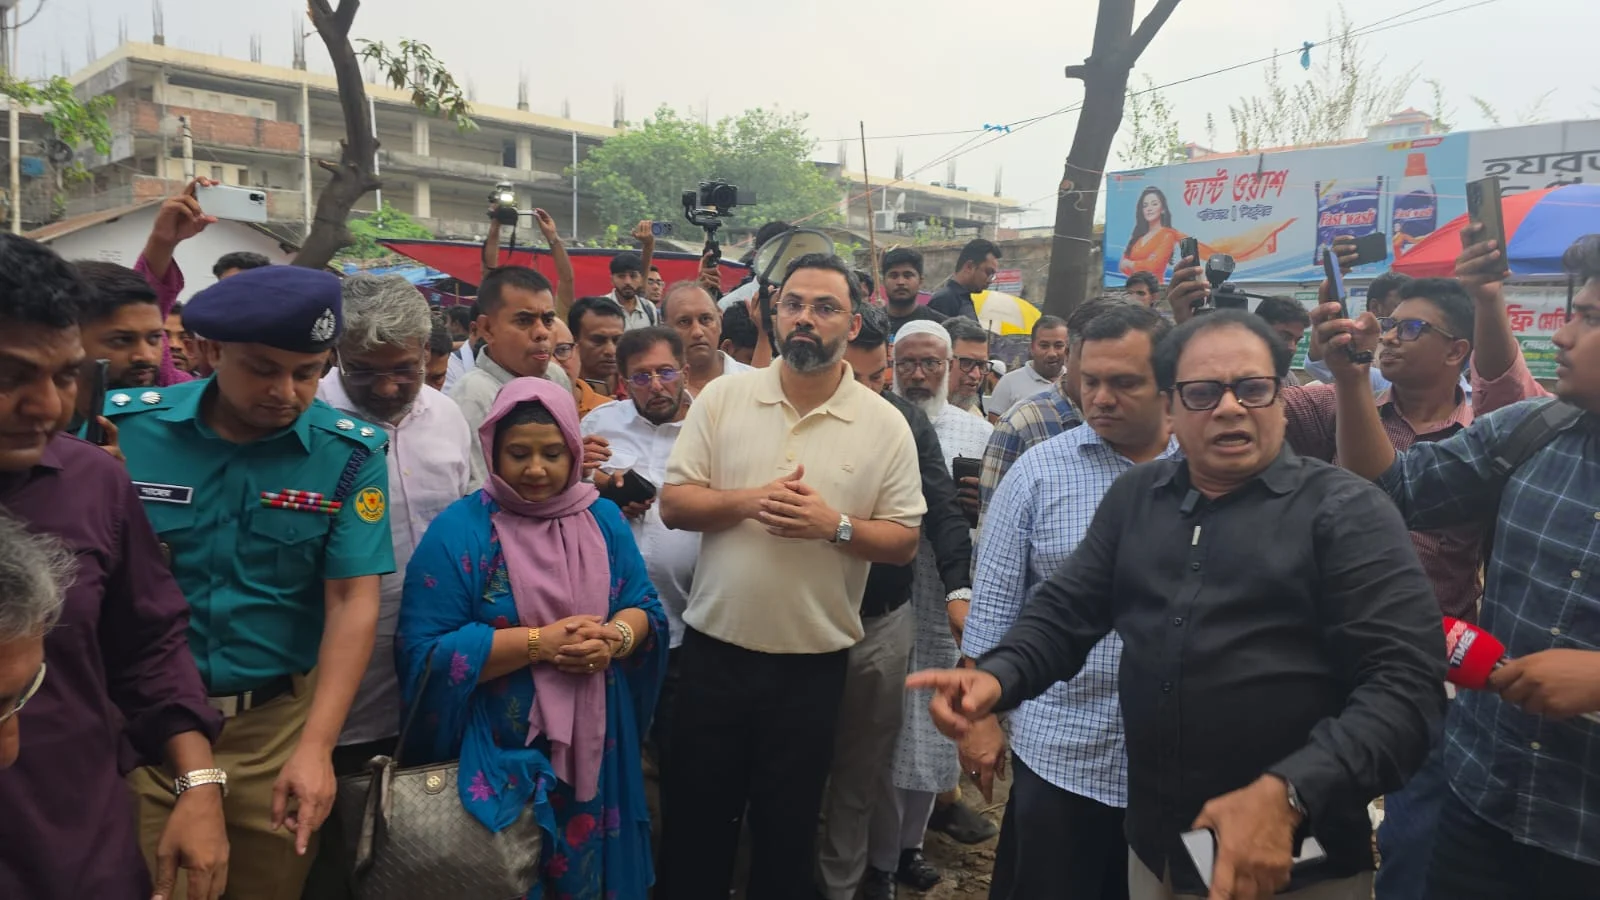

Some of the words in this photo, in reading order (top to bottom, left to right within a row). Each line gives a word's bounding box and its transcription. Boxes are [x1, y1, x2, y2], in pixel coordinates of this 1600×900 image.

[1184, 169, 1228, 206] ফাস্ট
[1232, 169, 1289, 203] ওয়াশ
[1449, 628, 1477, 665] TIMES
